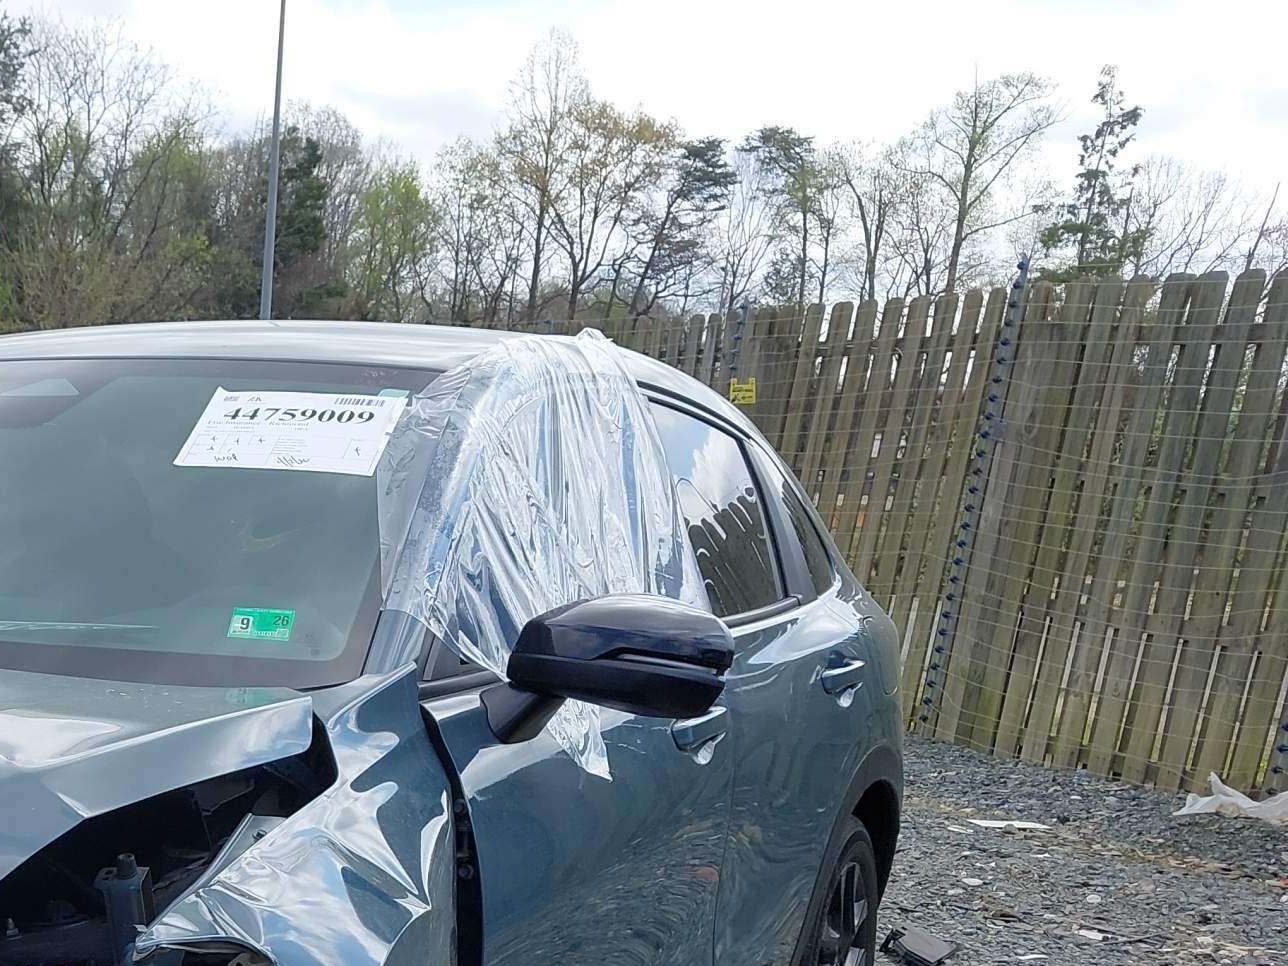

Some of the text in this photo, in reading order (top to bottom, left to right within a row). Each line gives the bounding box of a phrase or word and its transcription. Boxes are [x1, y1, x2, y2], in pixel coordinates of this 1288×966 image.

[223, 407, 375, 424] 44759009
[240, 615, 289, 630] 9 26
